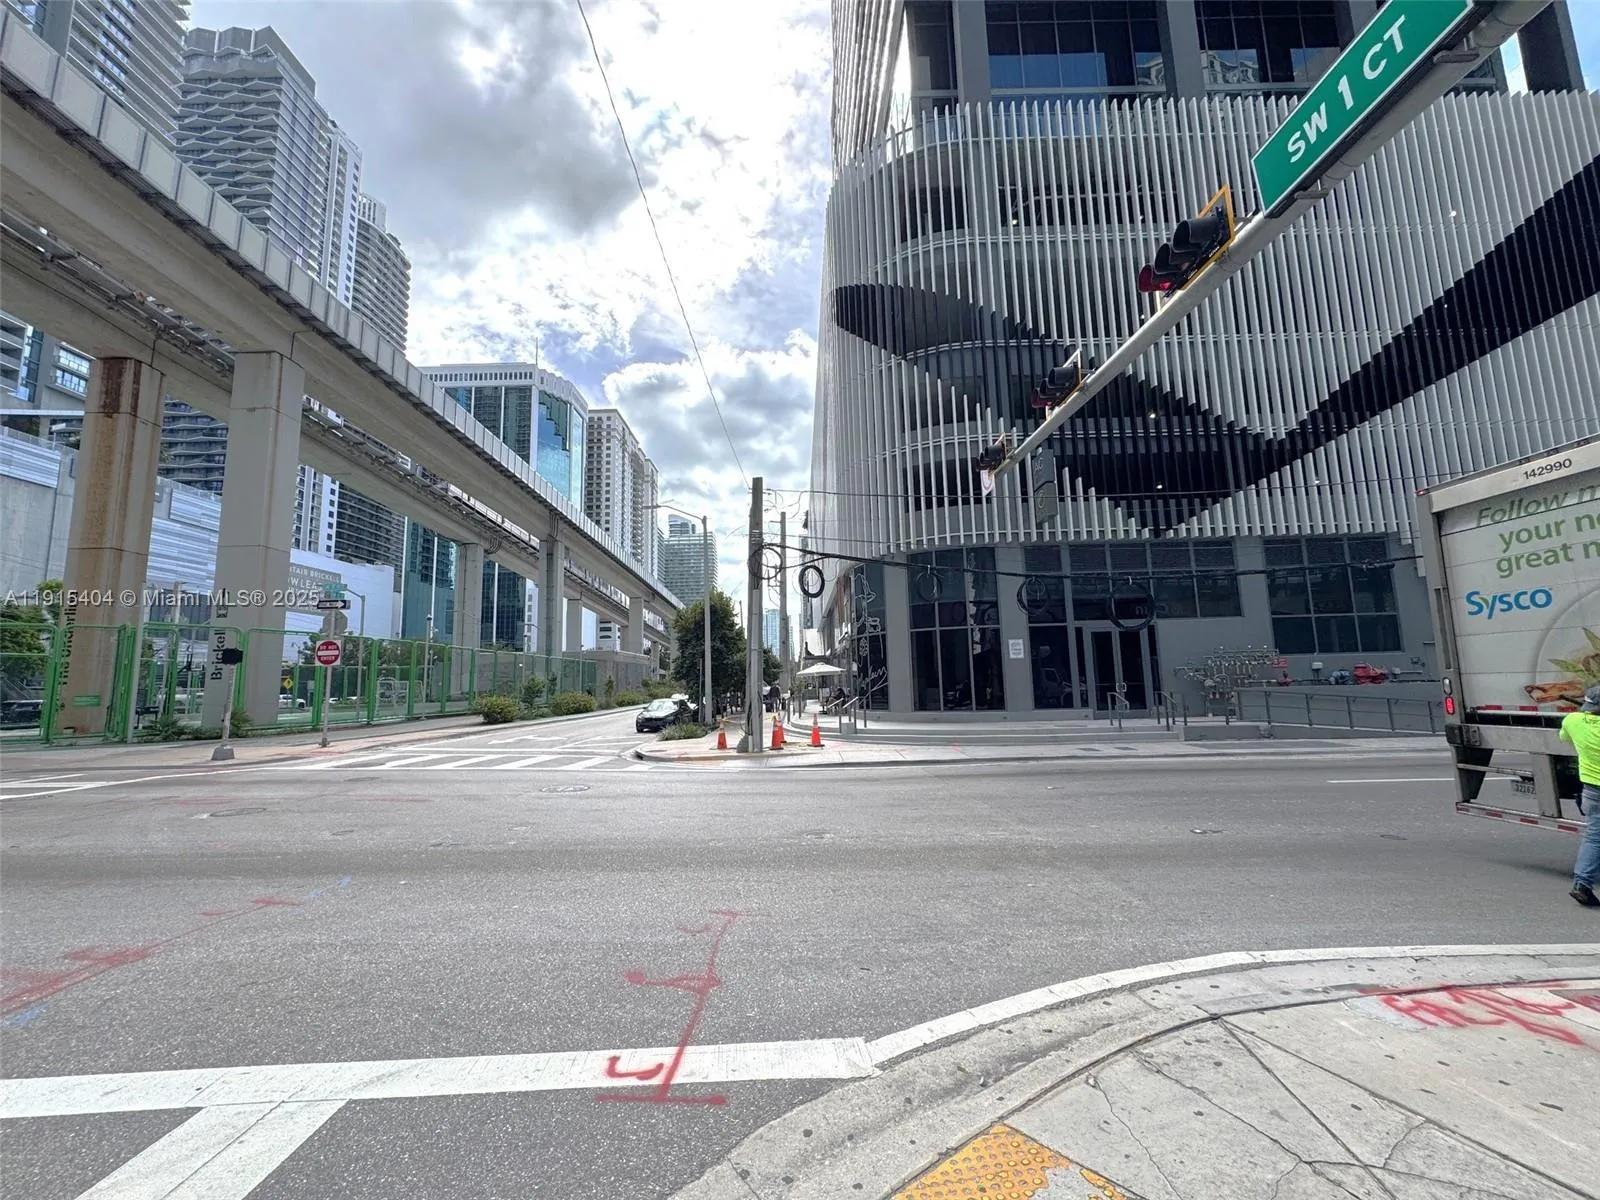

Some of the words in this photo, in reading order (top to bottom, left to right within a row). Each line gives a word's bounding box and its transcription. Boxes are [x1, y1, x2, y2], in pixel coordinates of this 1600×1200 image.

[1287, 101, 1328, 163] SW
[1337, 74, 1354, 111] 1
[1362, 14, 1407, 80] CT
[1523, 458, 1572, 479] 142990
[1476, 491, 1569, 527] Follow
[1499, 518, 1566, 554] your
[1496, 542, 1574, 579] great
[1466, 588, 1552, 620] Sysco
[210, 629, 226, 680] Brickell
